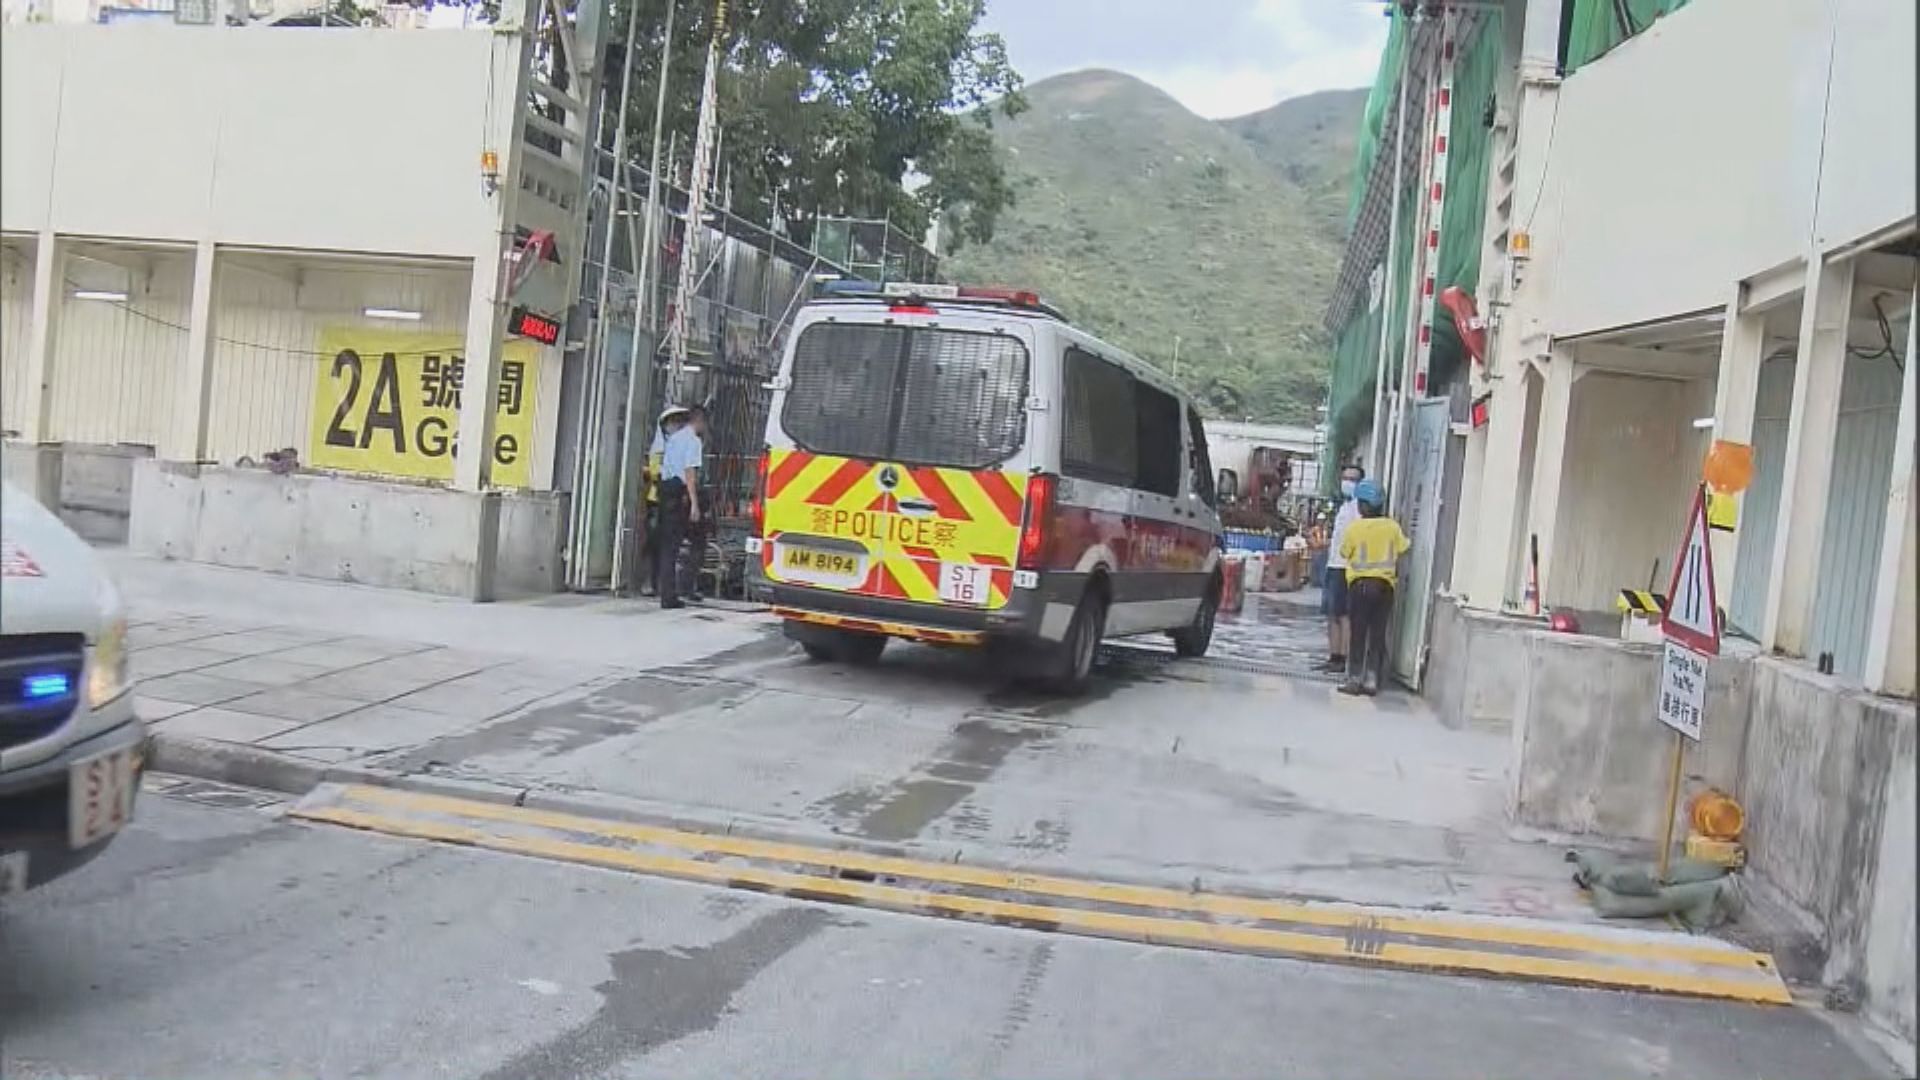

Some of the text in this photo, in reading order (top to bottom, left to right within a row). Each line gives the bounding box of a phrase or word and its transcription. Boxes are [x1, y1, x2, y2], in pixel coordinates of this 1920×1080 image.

[325, 349, 406, 453] 2A
[416, 416, 518, 465] Ge
[834, 510, 930, 545] POLICE
[789, 551, 854, 573] AM 8194
[951, 565, 980, 583] ST
[954, 583, 974, 600] 16
